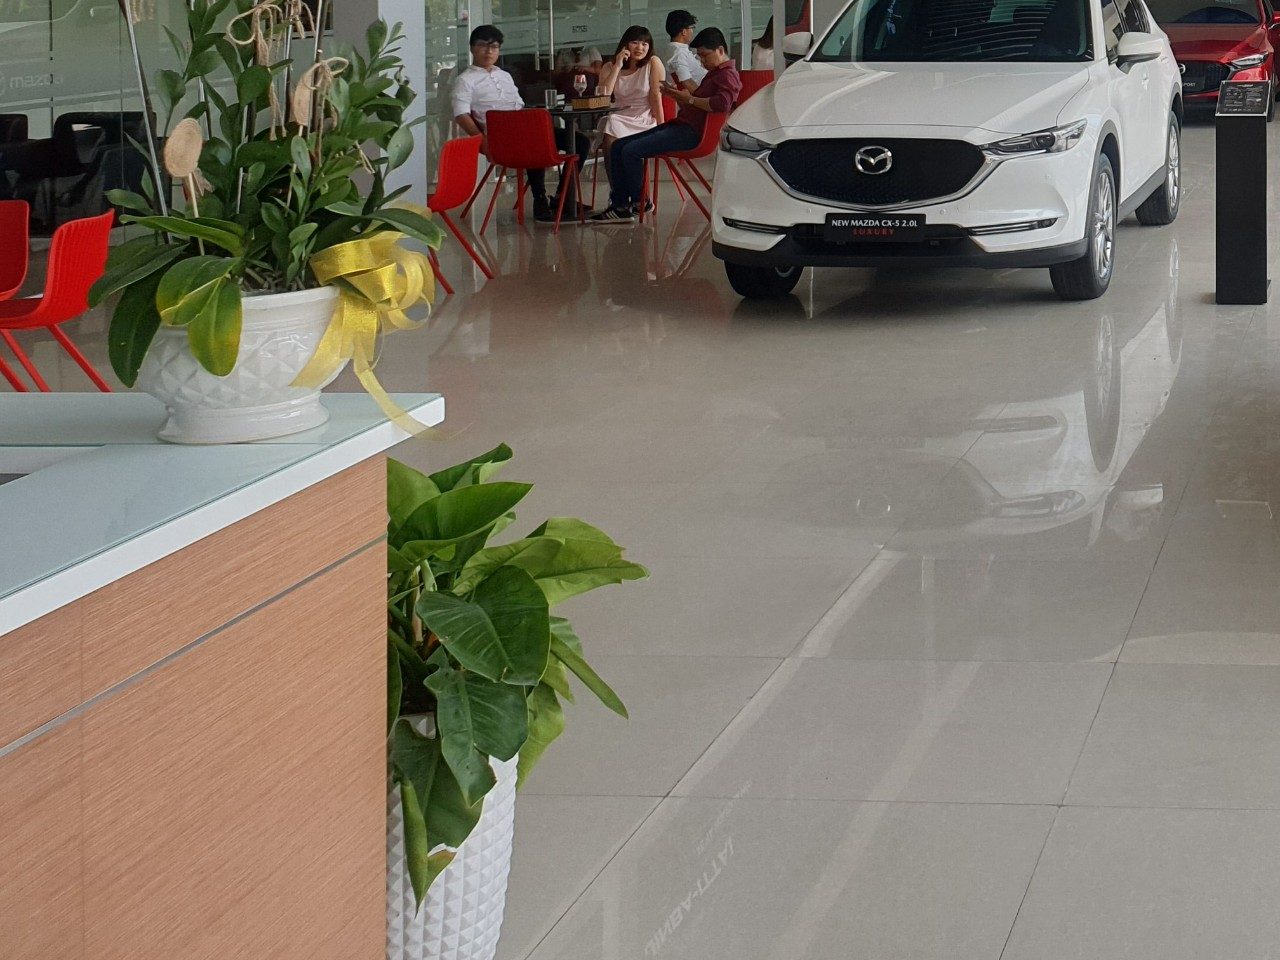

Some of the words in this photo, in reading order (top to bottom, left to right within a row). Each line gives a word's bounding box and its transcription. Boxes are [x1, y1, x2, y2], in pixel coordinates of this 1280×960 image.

[831, 219, 850, 227] NEW
[851, 219, 880, 227] MAZDA
[881, 219, 900, 227] CX-5
[901, 219, 918, 227] 2.0L
